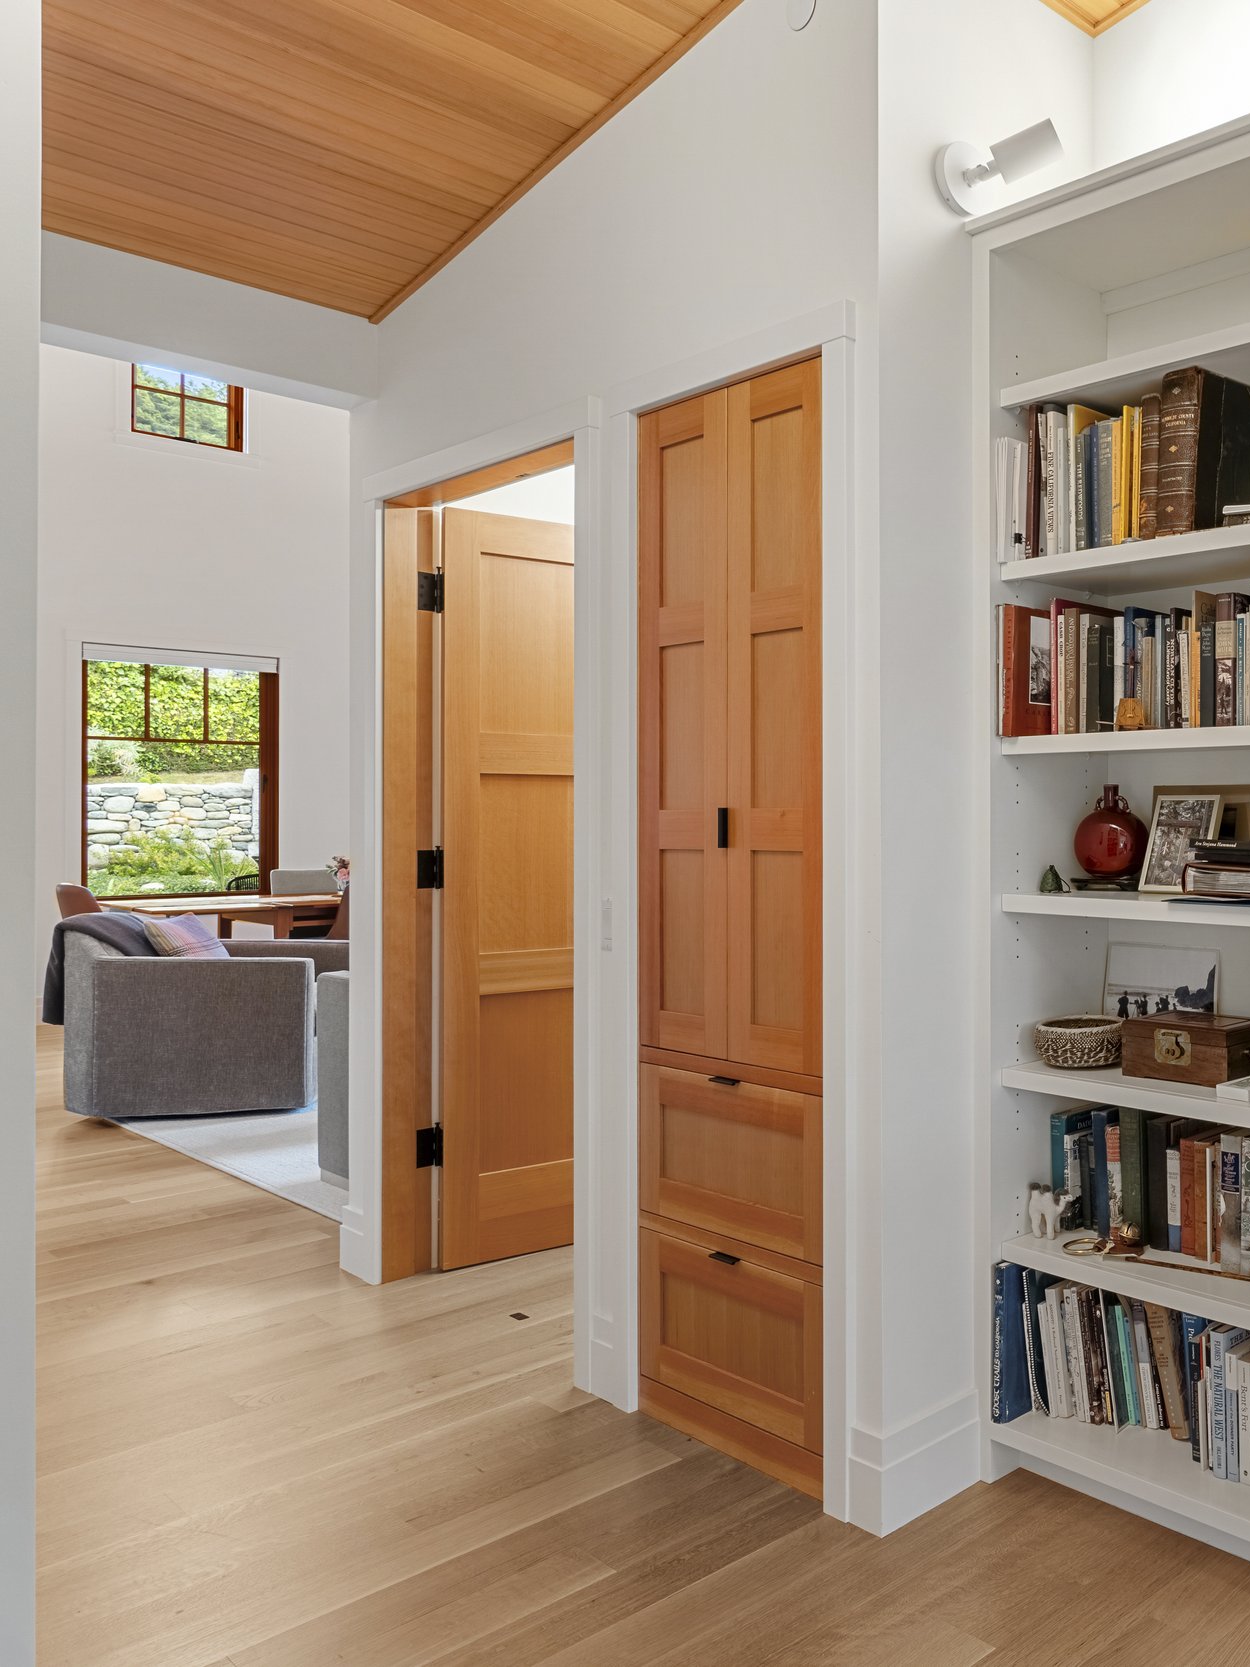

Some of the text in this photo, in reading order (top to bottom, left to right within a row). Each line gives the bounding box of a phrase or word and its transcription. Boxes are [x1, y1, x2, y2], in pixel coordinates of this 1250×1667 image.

[1047, 451, 1055, 469] FINE
[1047, 469, 1055, 511] CALIFORNIA
[1047, 511, 1055, 533] VIEWS
[1213, 1365, 1222, 1381] THE
[1214, 1382, 1223, 1417] NATURAL
[1214, 1419, 1224, 1441] WEST
